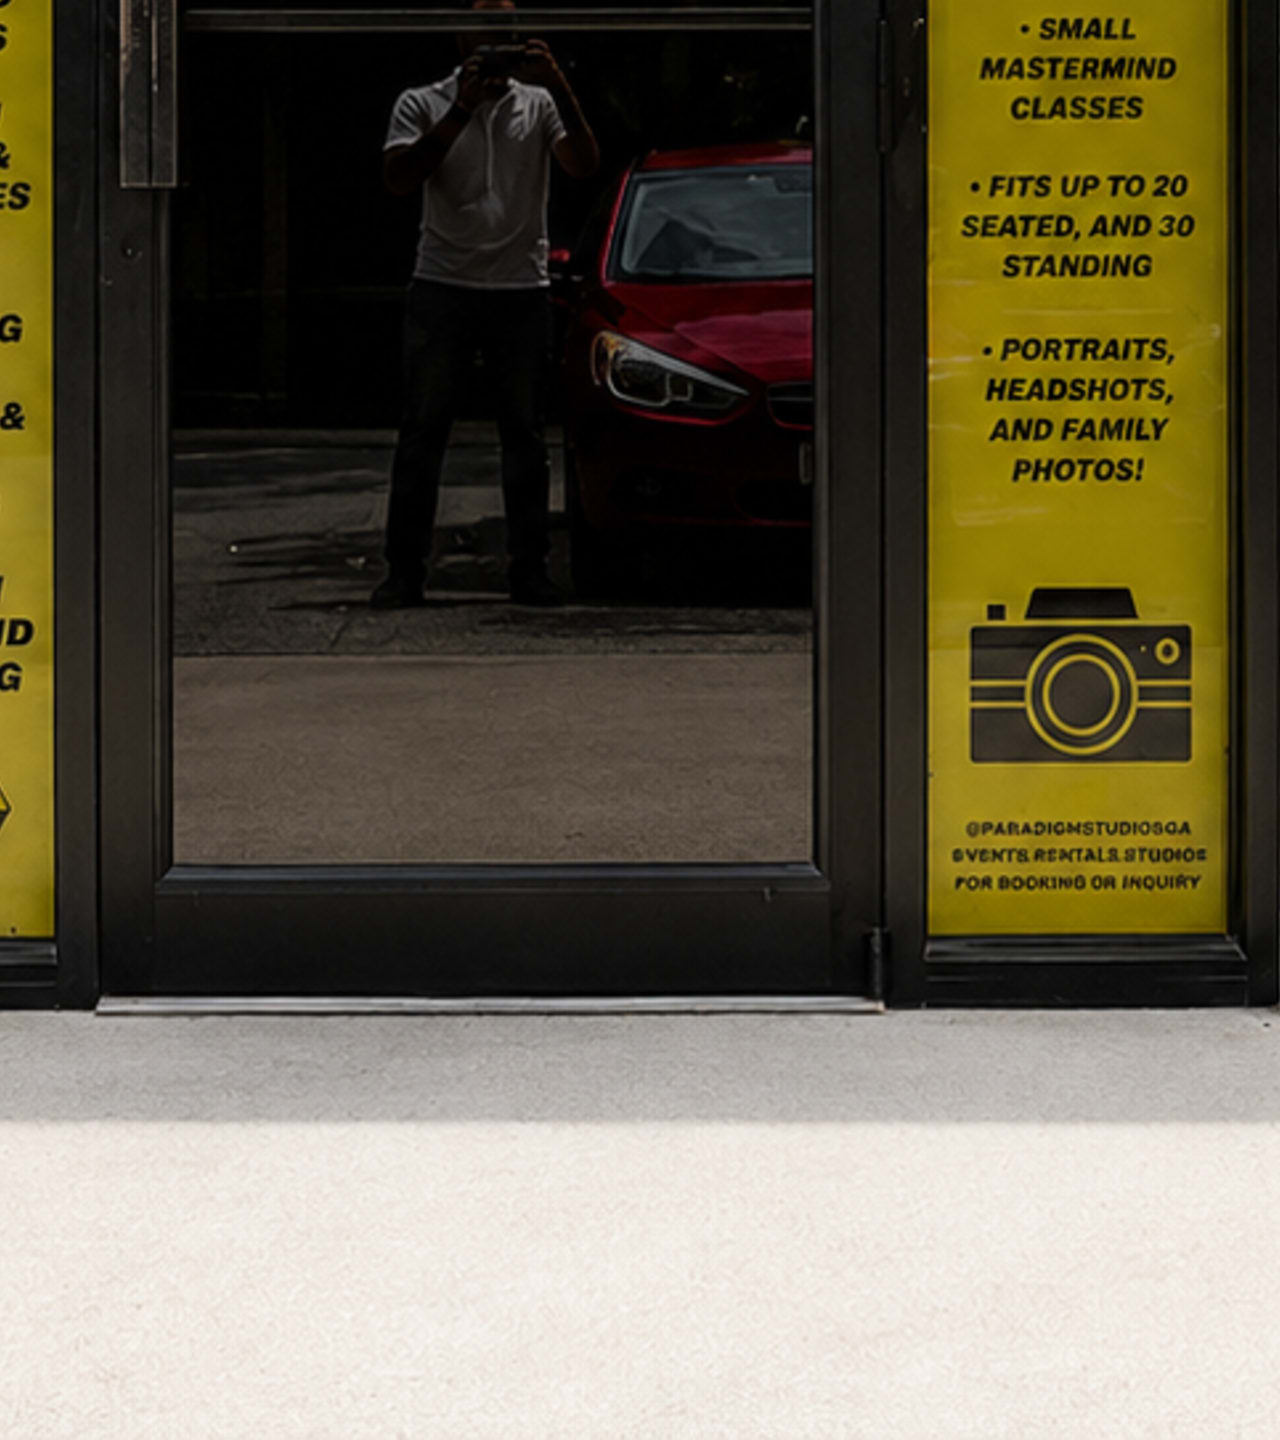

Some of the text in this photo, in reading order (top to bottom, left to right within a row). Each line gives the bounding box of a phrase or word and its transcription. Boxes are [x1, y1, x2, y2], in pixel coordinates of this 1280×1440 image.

[1039, 17, 1136, 41] SMALL
[979, 56, 1177, 81] MASTERMIND
[1010, 95, 1143, 121] CLASSES
[988, 174, 1188, 198] FITS UP TO 20
[961, 214, 1196, 241] SEATED, AND 30
[1002, 253, 1153, 278] STANDING
[1000, 337, 1175, 365] PORTRAITS,
[985, 377, 1174, 405] HEADSHOTS,
[989, 417, 1169, 442] AND FAMILY
[1012, 458, 1144, 483] PHOTOS!
